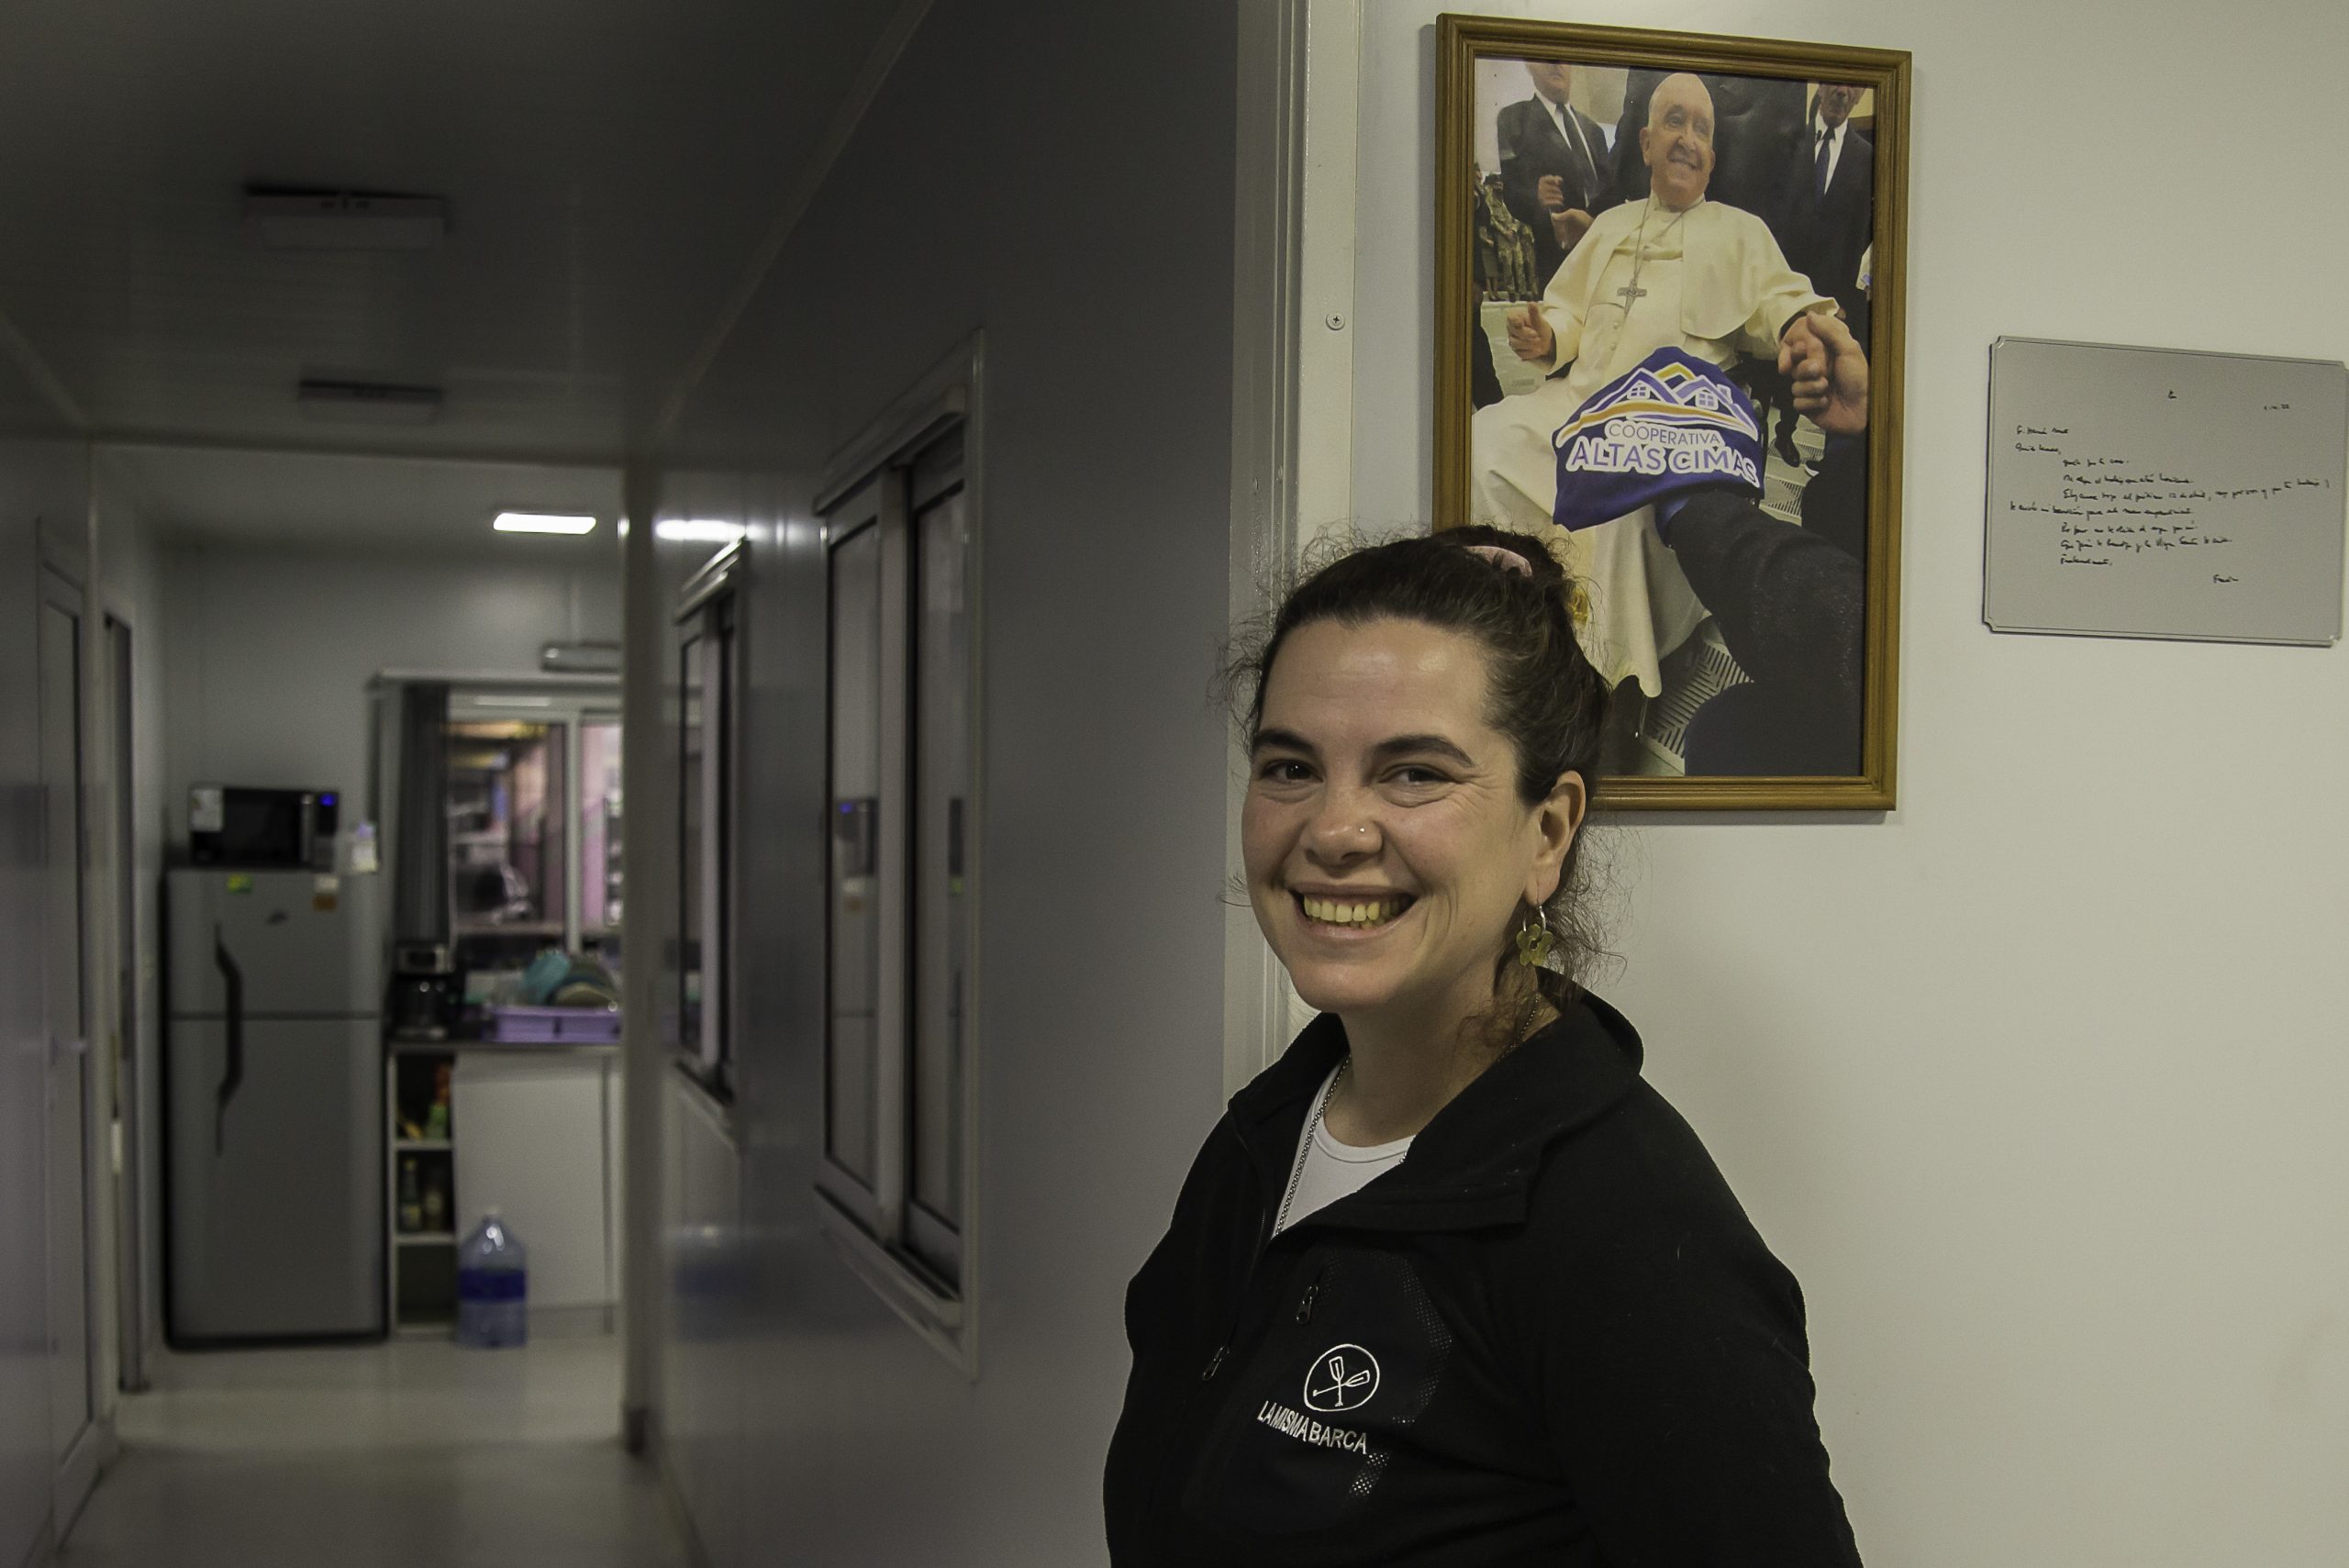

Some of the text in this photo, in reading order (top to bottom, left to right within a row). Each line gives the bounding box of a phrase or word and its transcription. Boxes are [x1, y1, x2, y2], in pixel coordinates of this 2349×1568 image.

[1608, 424, 1721, 445] COOPERATIVA
[1570, 440, 1758, 484] ALTAS CIMAS
[1256, 1400, 1367, 1455] LA MISMA BARCA
